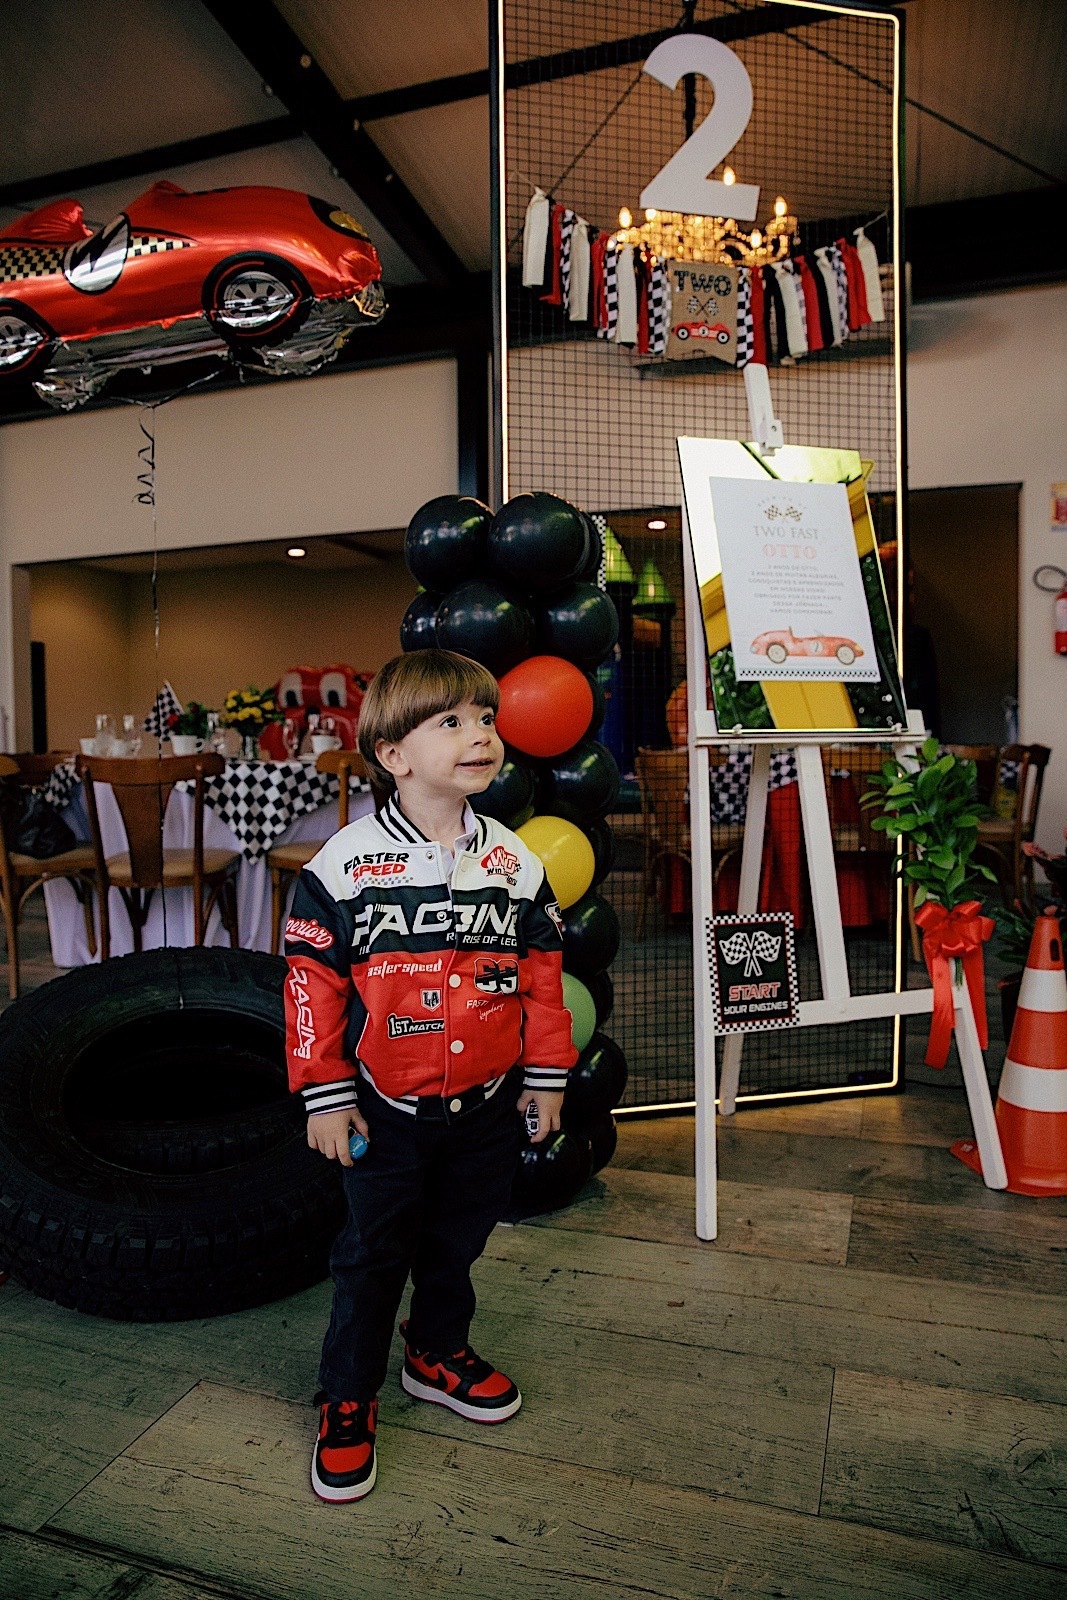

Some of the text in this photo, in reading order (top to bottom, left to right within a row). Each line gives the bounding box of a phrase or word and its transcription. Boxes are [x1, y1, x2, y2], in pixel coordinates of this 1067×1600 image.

[640, 33, 760, 221] 2
[674, 270, 732, 296] TWO
[754, 525, 819, 540] TWO FAST
[763, 543, 817, 560] OTTO
[343, 852, 410, 875] FASTER
[352, 863, 406, 883] SPEED
[482, 935, 499, 945] OF
[729, 982, 781, 1001] START
[724, 1001, 788, 1015] YOUR ENGINES
